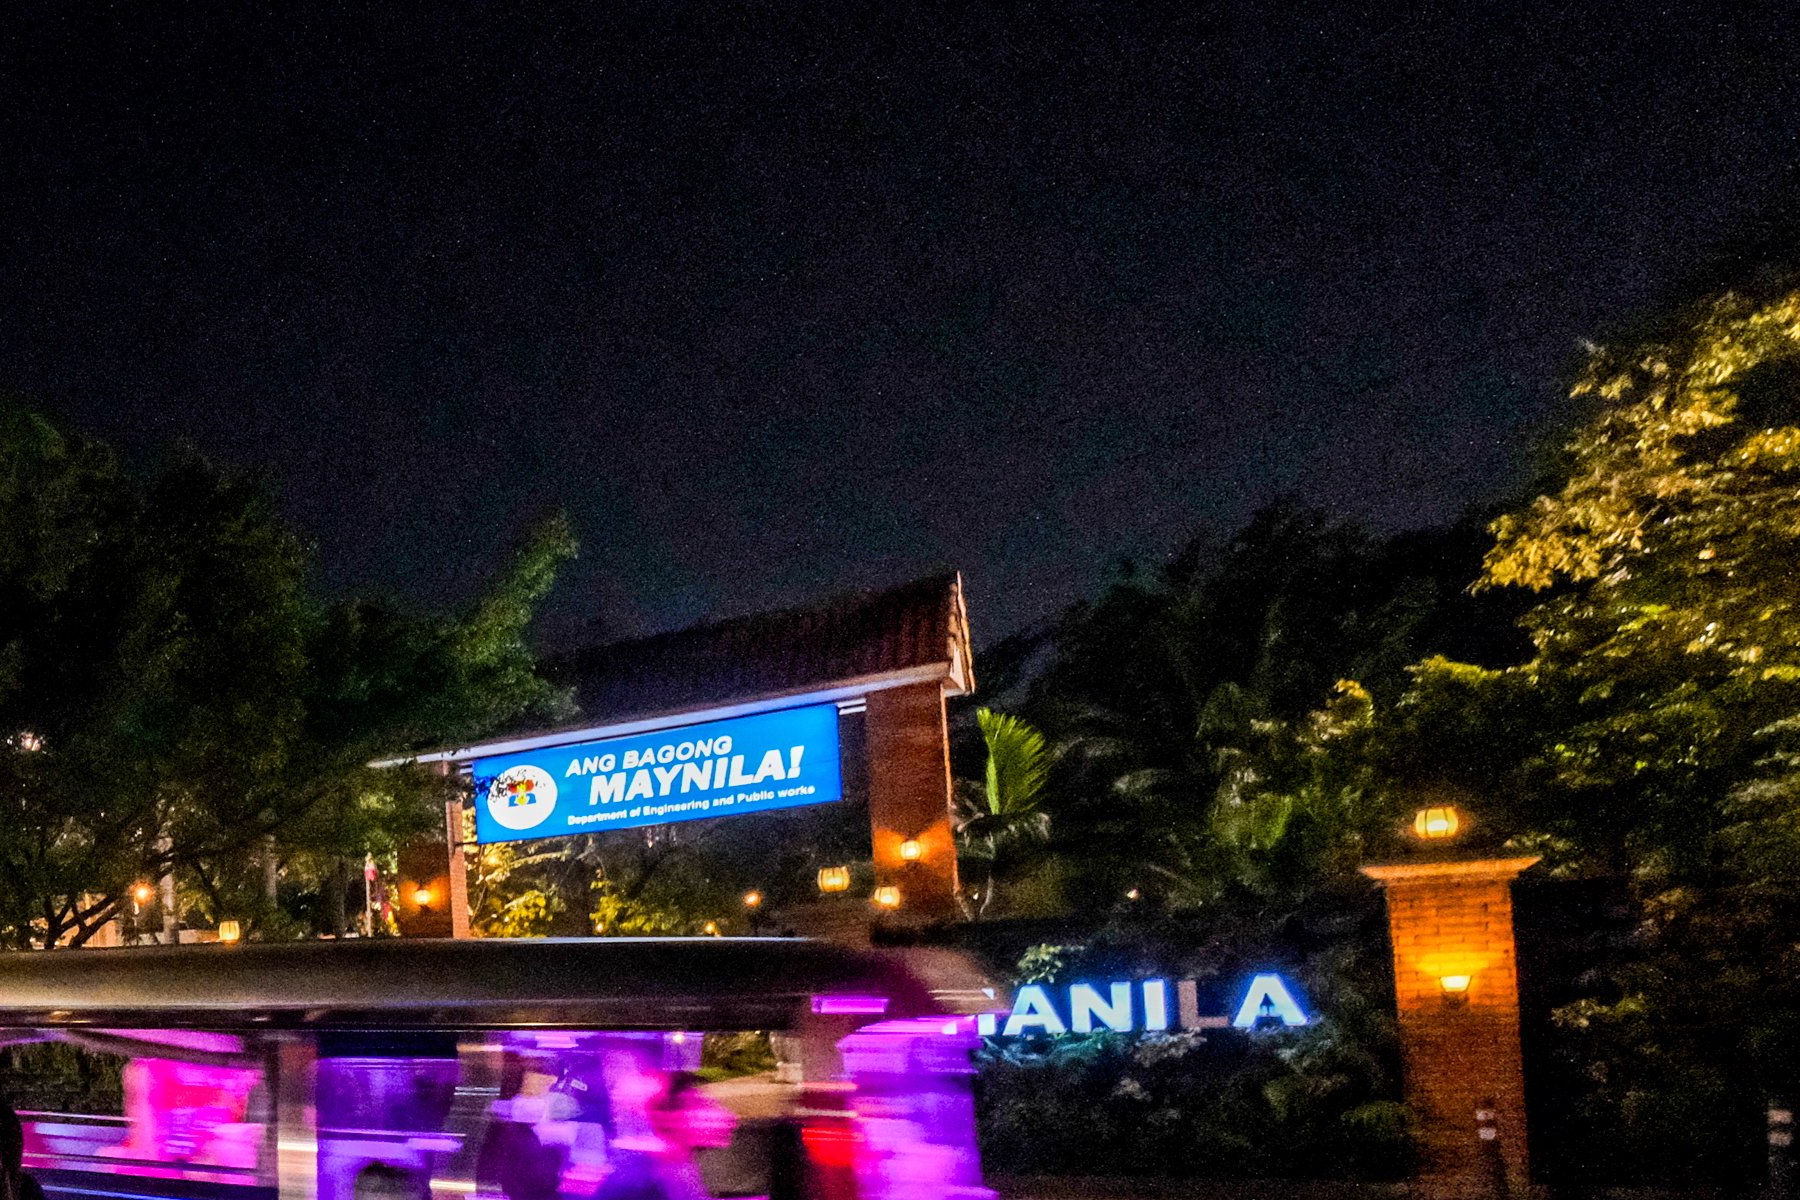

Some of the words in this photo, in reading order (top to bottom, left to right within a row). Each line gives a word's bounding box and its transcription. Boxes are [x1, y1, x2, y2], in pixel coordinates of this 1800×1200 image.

[565, 753, 616, 778] ANG
[622, 735, 733, 769] BAGONG
[589, 745, 805, 805] MAYNILA!
[567, 809, 628, 826] Department
[629, 806, 642, 818] of
[643, 799, 710, 816] Engineering
[712, 795, 735, 807] and
[737, 789, 775, 804] Public
[777, 785, 816, 798] works
